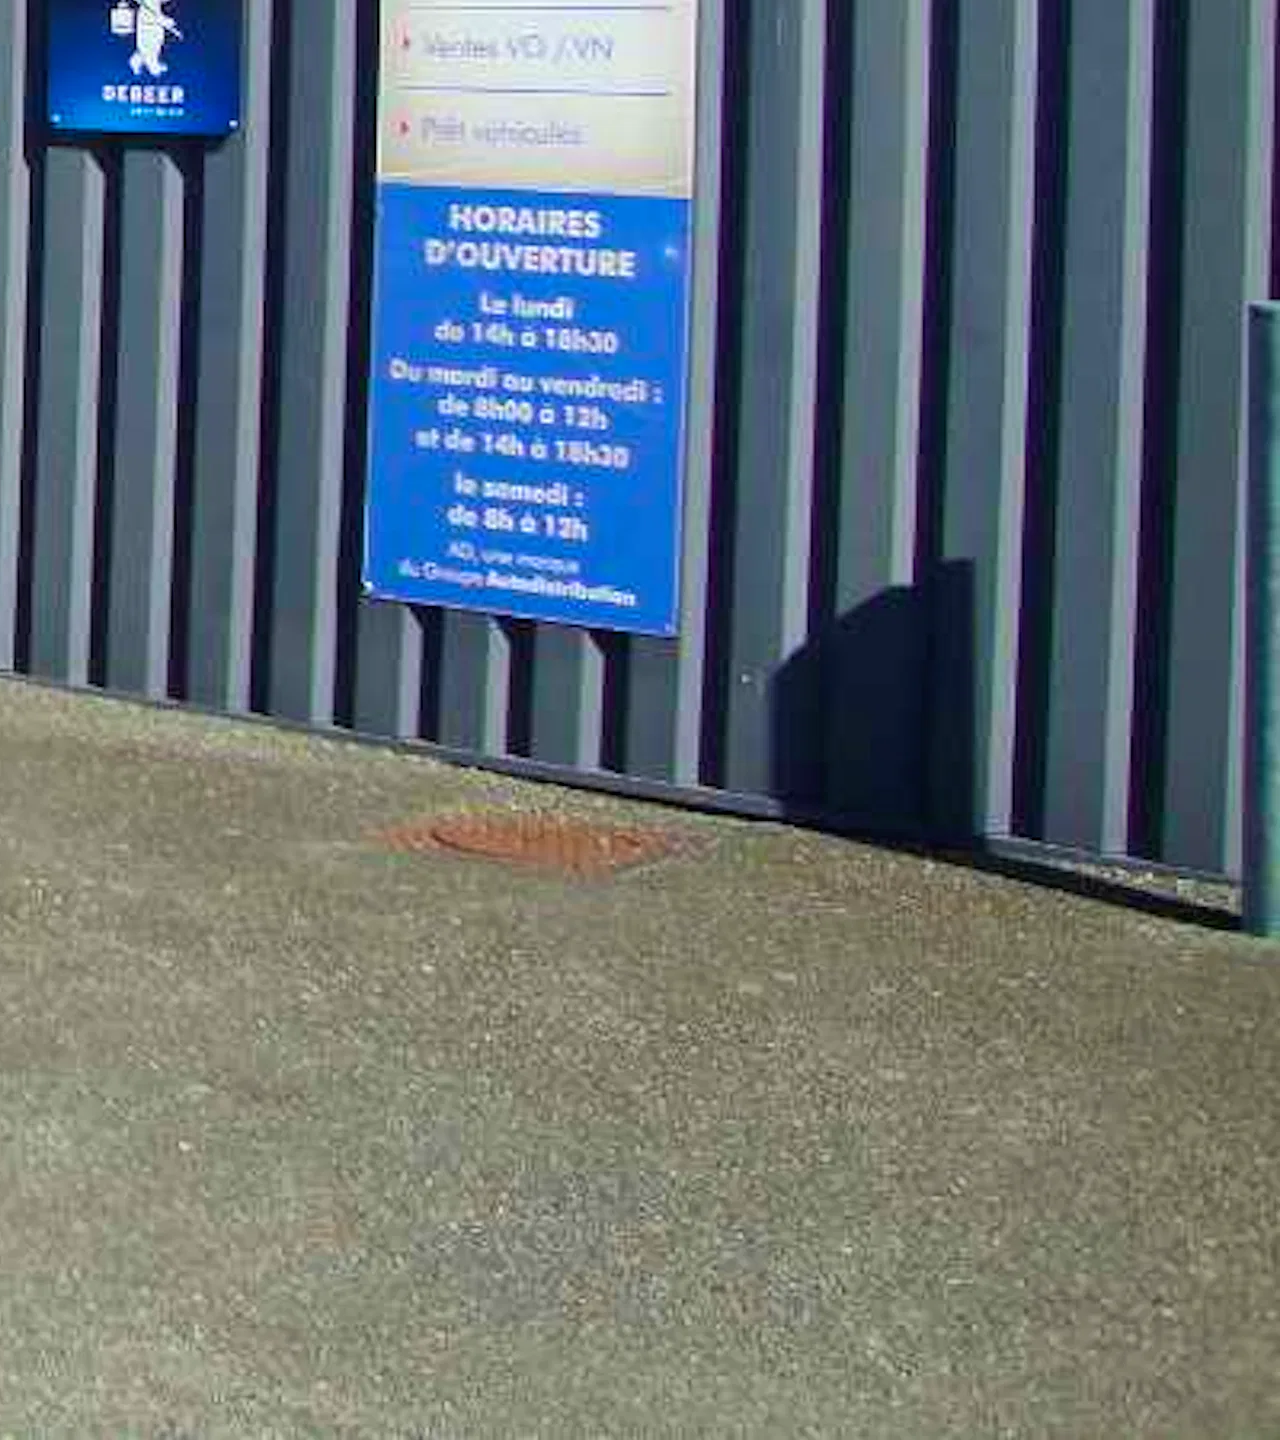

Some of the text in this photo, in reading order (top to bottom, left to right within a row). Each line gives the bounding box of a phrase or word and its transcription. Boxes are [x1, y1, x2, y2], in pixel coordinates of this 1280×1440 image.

[448, 203, 602, 239] HORAIRES
[424, 238, 636, 278] D'OUVERTURE
[513, 293, 576, 320] lundi
[434, 319, 465, 343] de
[473, 320, 515, 348] 14h
[545, 327, 619, 355] 18h30
[390, 357, 422, 382] Du
[428, 363, 498, 391] mardi
[503, 373, 536, 393] au
[540, 374, 648, 404] vendredi
[439, 394, 469, 419] de
[443, 428, 475, 454] de
[483, 432, 525, 459] 14h
[483, 476, 571, 508] samedi
[447, 503, 478, 528] de
